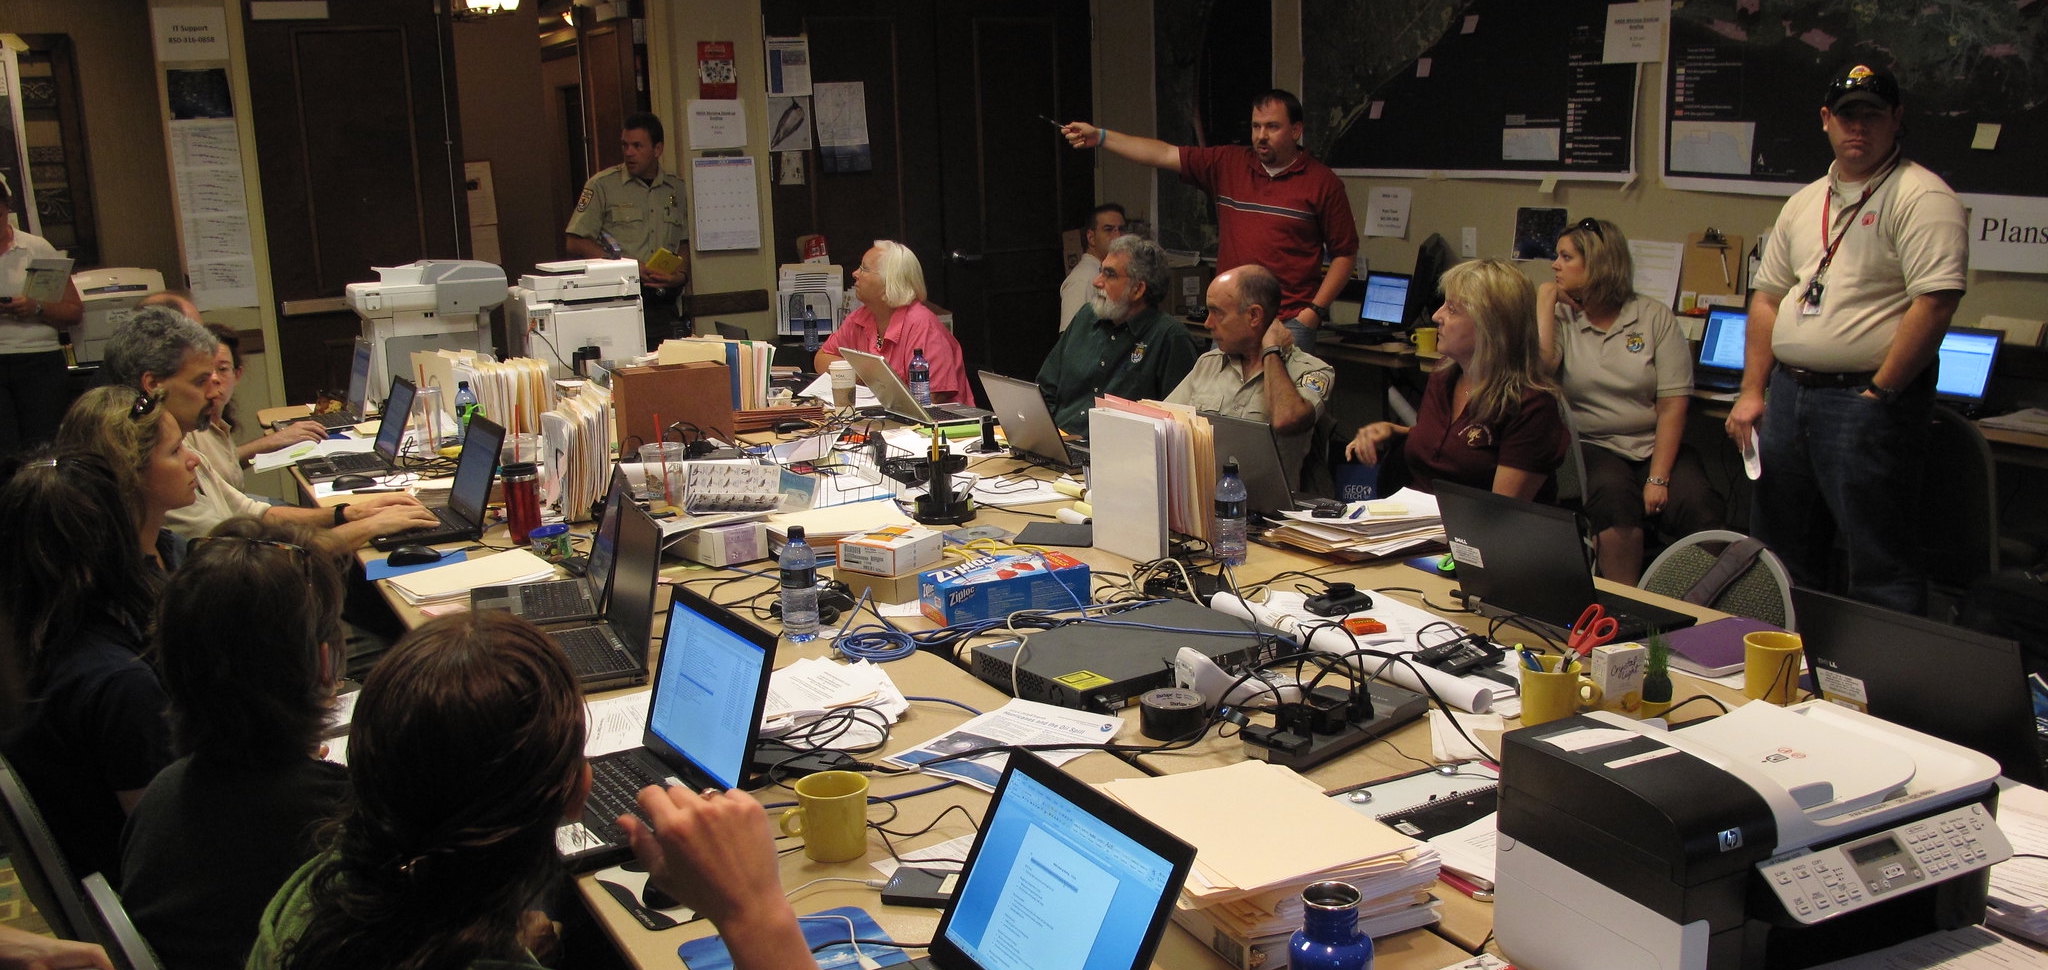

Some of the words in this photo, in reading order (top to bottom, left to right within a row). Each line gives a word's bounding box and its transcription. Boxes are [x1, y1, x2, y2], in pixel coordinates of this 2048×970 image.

[180, 25, 208, 33] Support
[1978, 217, 2048, 244] Plans
[927, 555, 996, 584] Ziploc
[949, 586, 976, 607] Ziploc
[1003, 711, 1036, 723] Hurricanes
[1048, 721, 1059, 729] the
[1070, 727, 1087, 736] Spill
